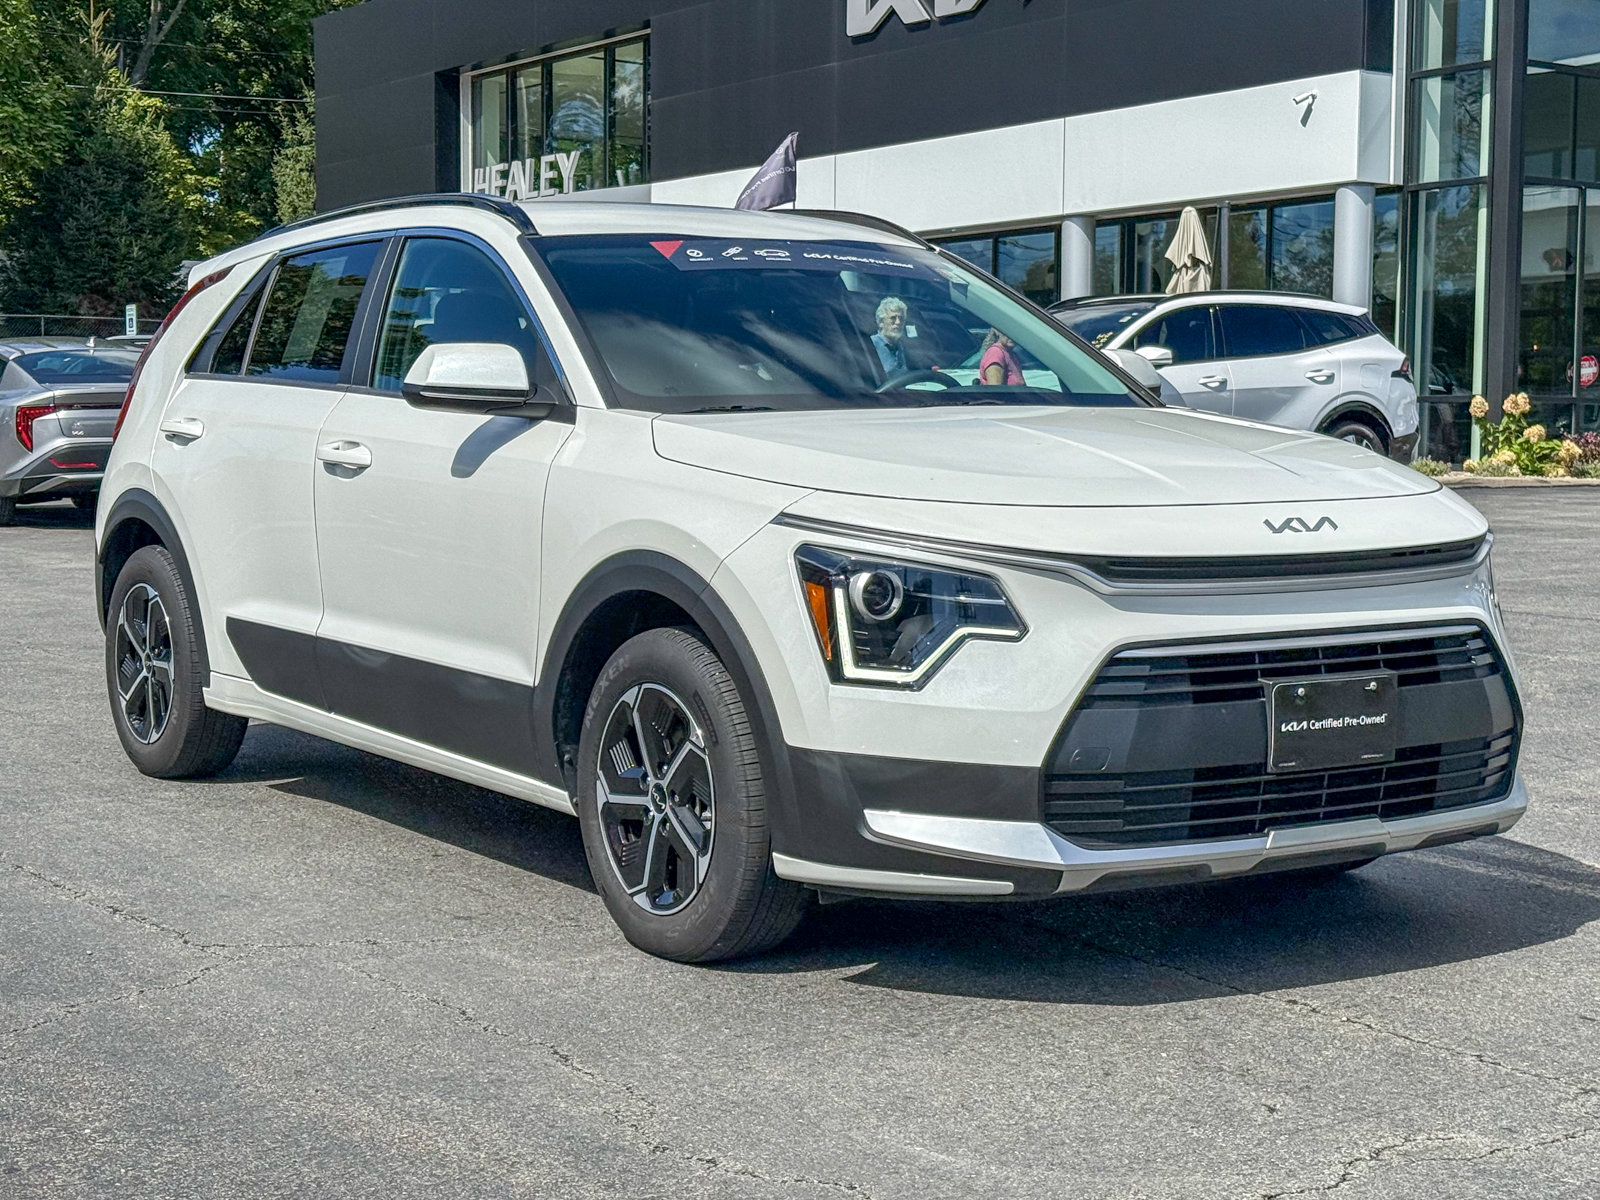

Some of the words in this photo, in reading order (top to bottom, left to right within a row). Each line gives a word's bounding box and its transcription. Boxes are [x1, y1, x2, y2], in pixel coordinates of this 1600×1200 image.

[474, 150, 580, 200] HEALEY
[1262, 516, 1339, 534] KIA
[1281, 721, 1308, 732] KIA
[1309, 717, 1343, 730] Certified
[1344, 713, 1387, 727] Pre-Owned
